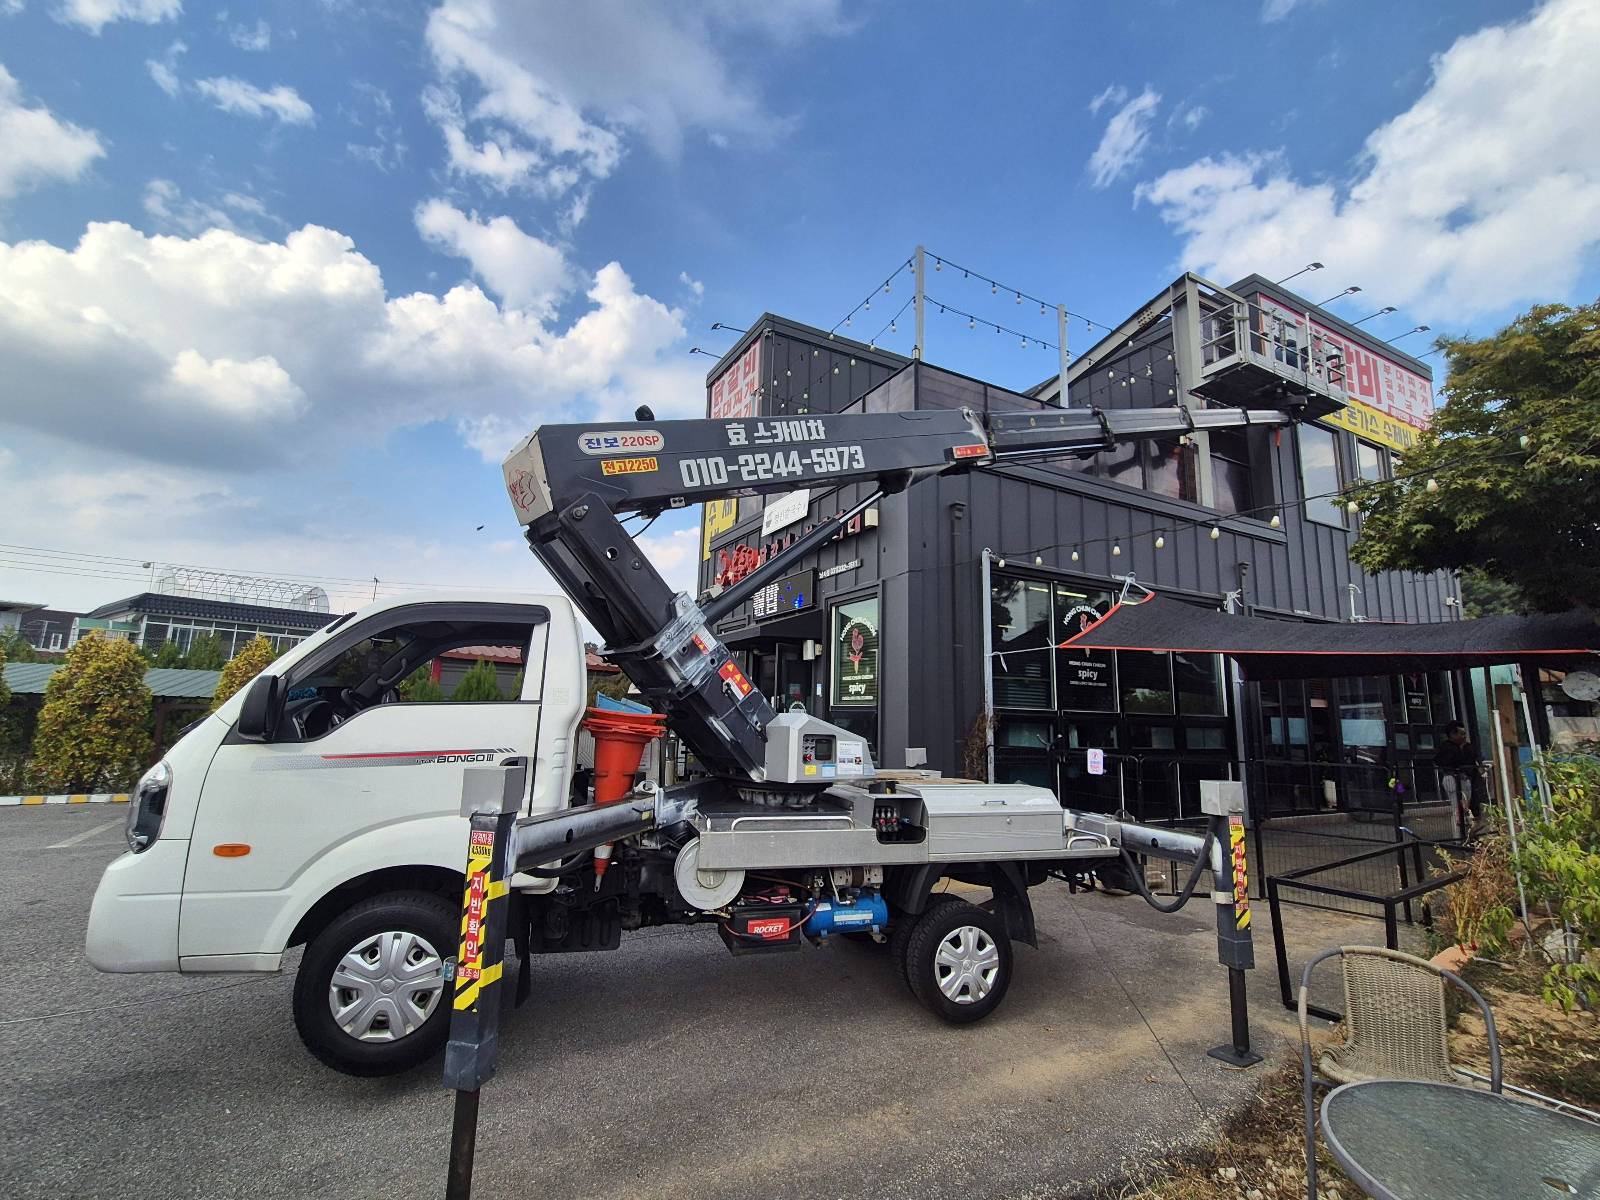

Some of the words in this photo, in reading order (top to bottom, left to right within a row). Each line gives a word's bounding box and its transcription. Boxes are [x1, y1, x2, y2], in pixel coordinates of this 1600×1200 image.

[725, 422, 748, 446] 효
[753, 419, 826, 443] 스카이차
[584, 436, 620, 450] 진보
[620, 435, 660, 447] 220SP
[603, 458, 657, 474] 전고2250
[679, 445, 866, 488] 010-2244-5973
[1063, 607, 1077, 626] HONG
[1078, 668, 1098, 681] spicy
[848, 682, 866, 695] spicy
[437, 753, 485, 764] BONGO
[466, 875, 484, 959] 지반확인
[753, 925, 784, 934] ROCKET
